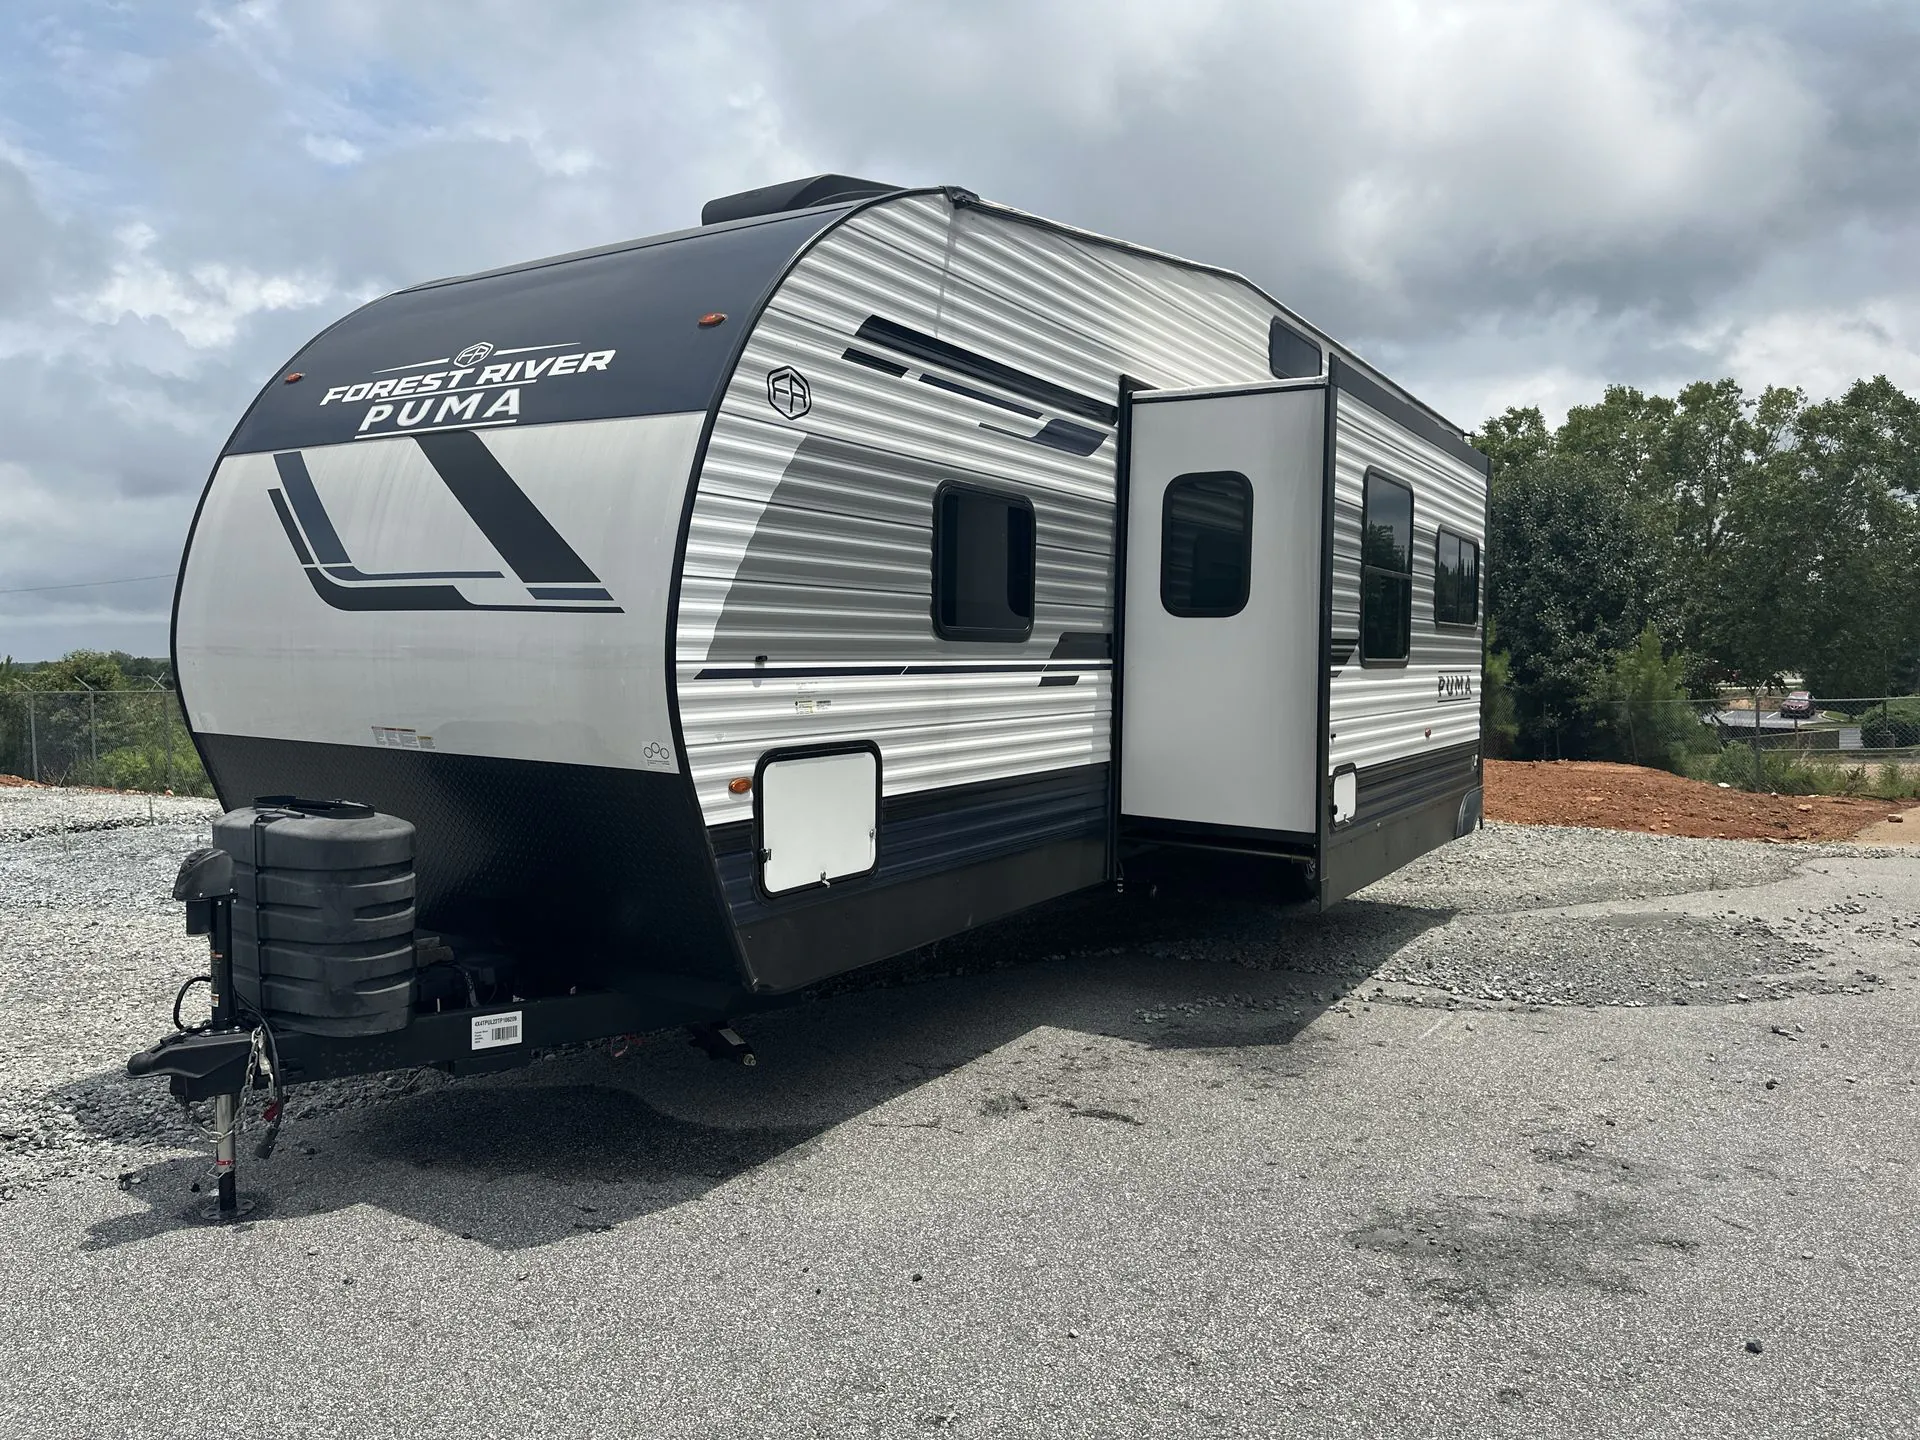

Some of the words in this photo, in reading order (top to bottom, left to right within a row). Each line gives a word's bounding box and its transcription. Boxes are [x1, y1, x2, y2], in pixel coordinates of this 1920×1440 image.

[319, 367, 476, 406] FOREST
[475, 349, 617, 386] RIVER
[357, 387, 521, 432] PUMA
[1437, 674, 1473, 698] PUMA
